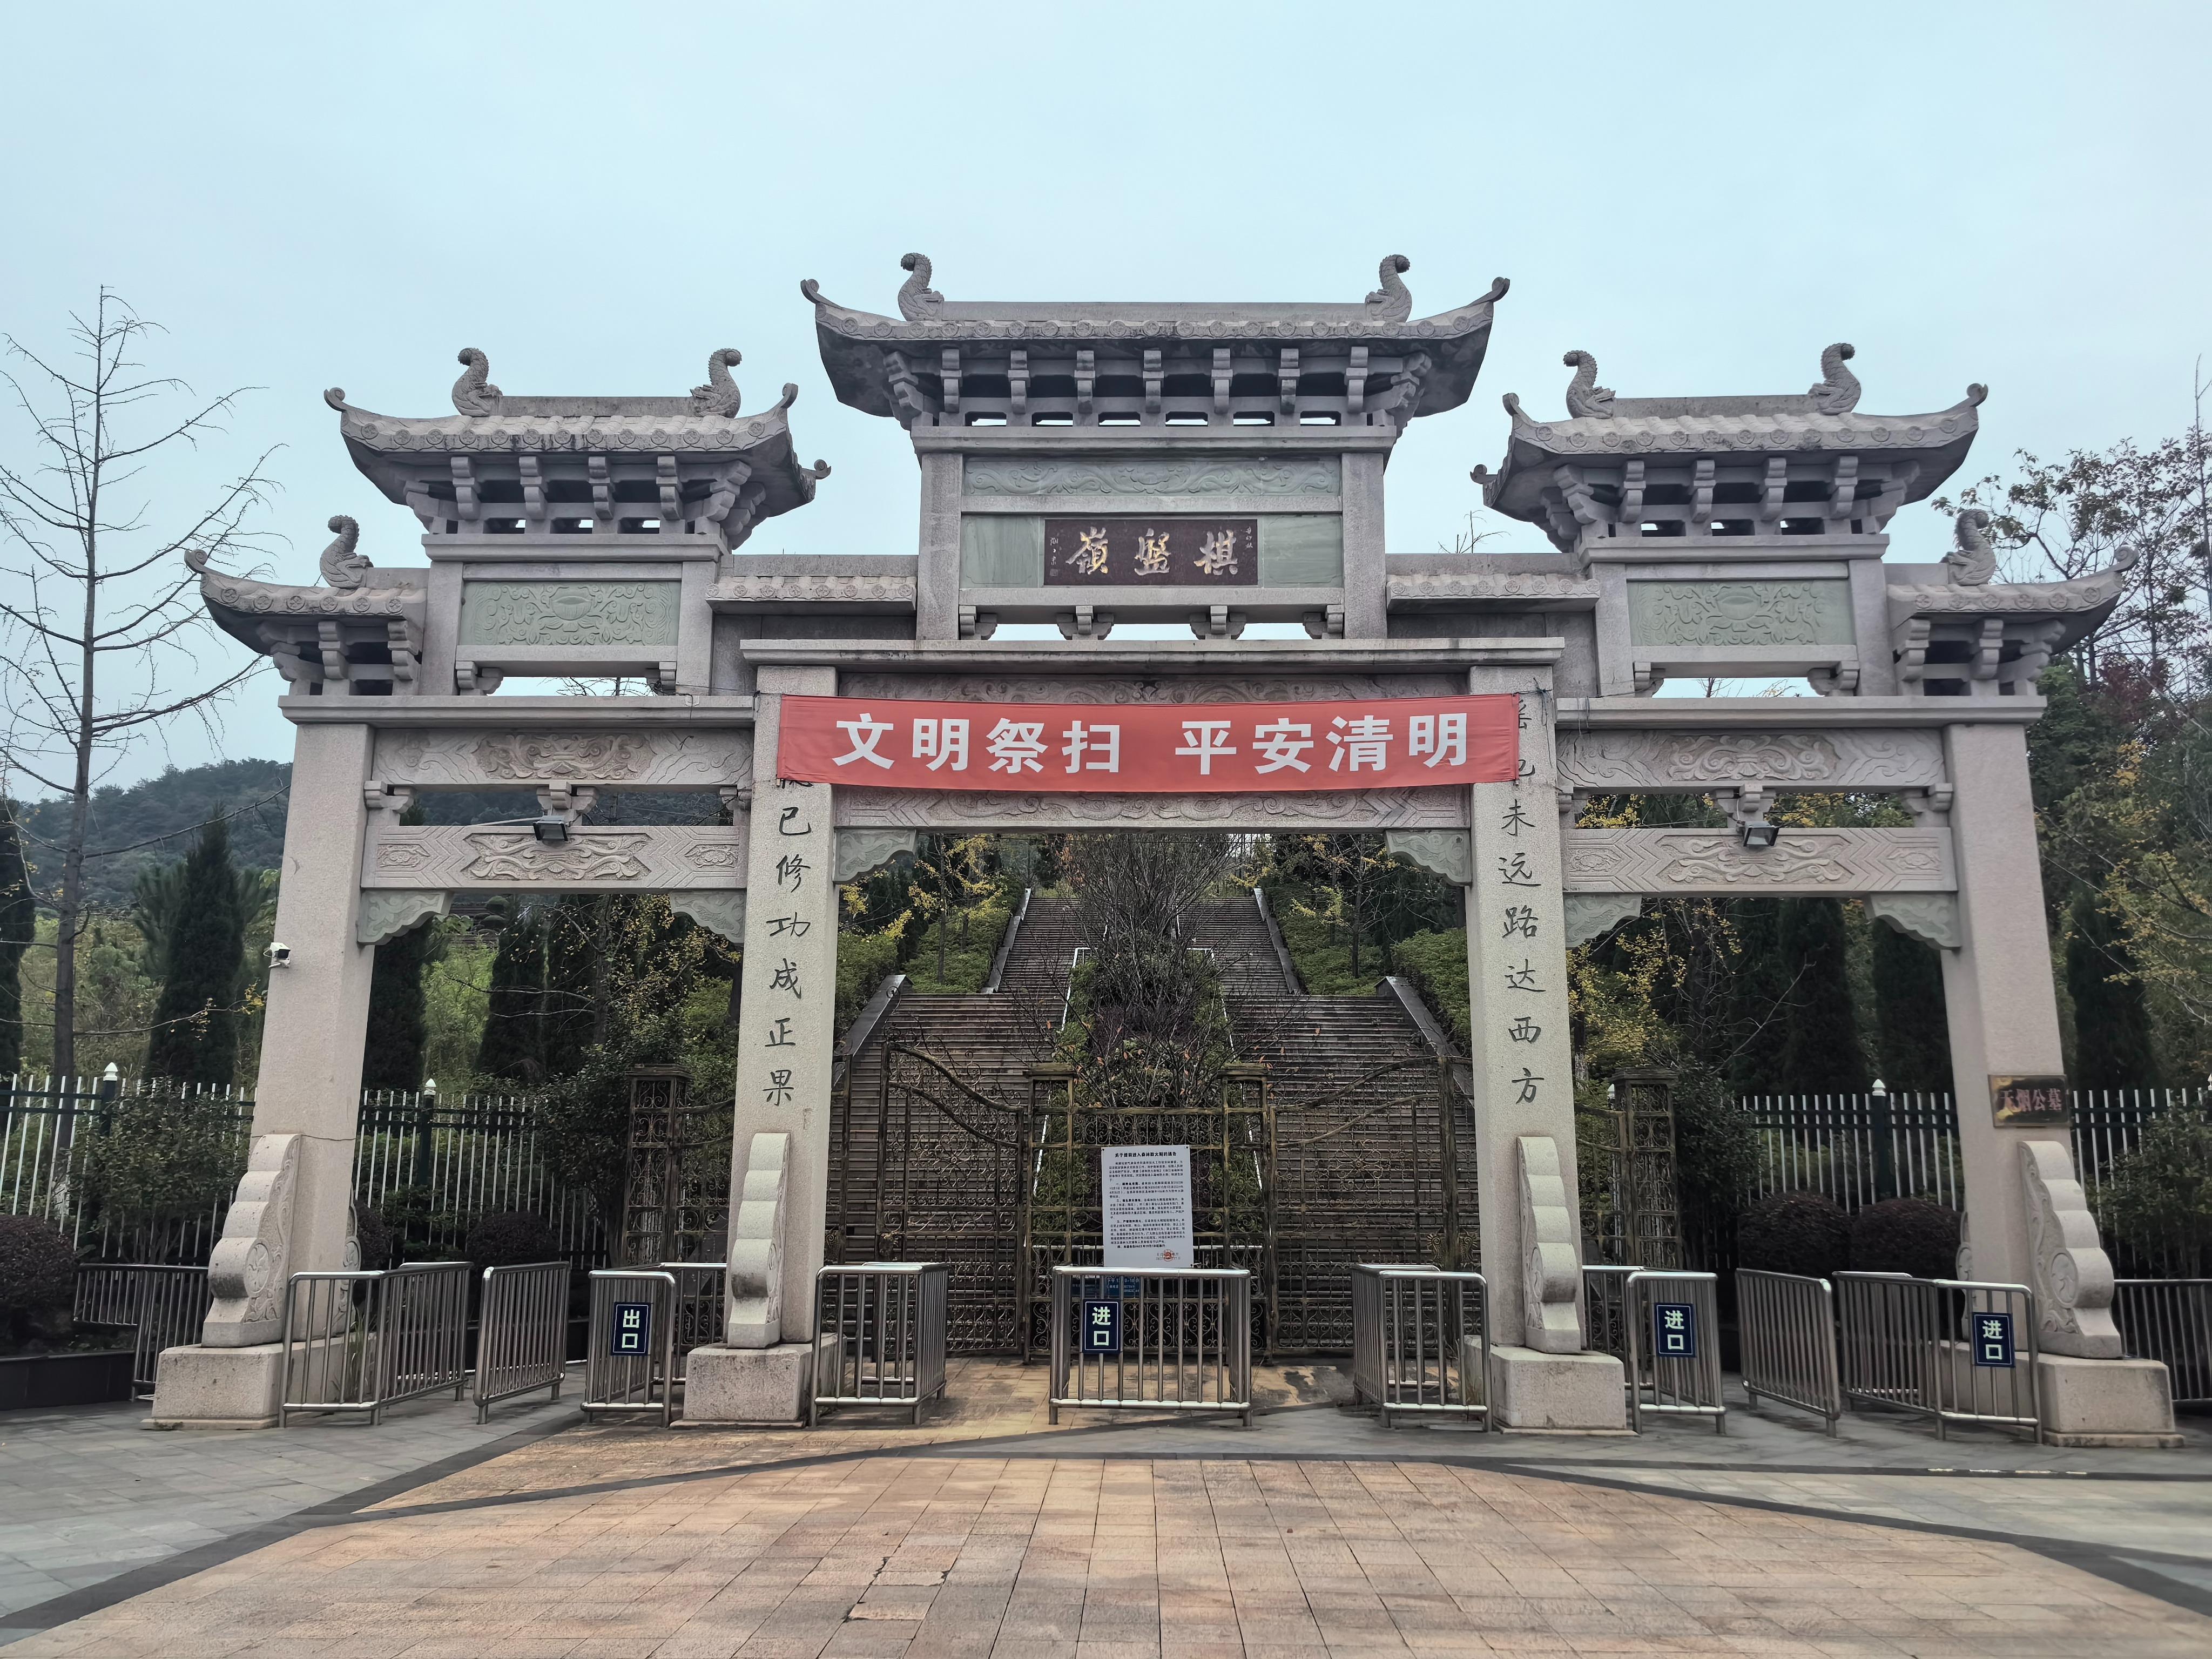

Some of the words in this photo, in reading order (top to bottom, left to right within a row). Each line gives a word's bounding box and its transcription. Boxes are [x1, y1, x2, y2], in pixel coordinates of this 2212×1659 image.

[832, 713, 1120, 773] 文明祭扫
[1175, 713, 1467, 774] 平安清明
[763, 779, 813, 1106] 已修功成正果
[622, 1309, 640, 1348] 出口
[1092, 1306, 1111, 1346] 进口
[1664, 1310, 1684, 1350] 进口
[1982, 1320, 2004, 1360] 进口
